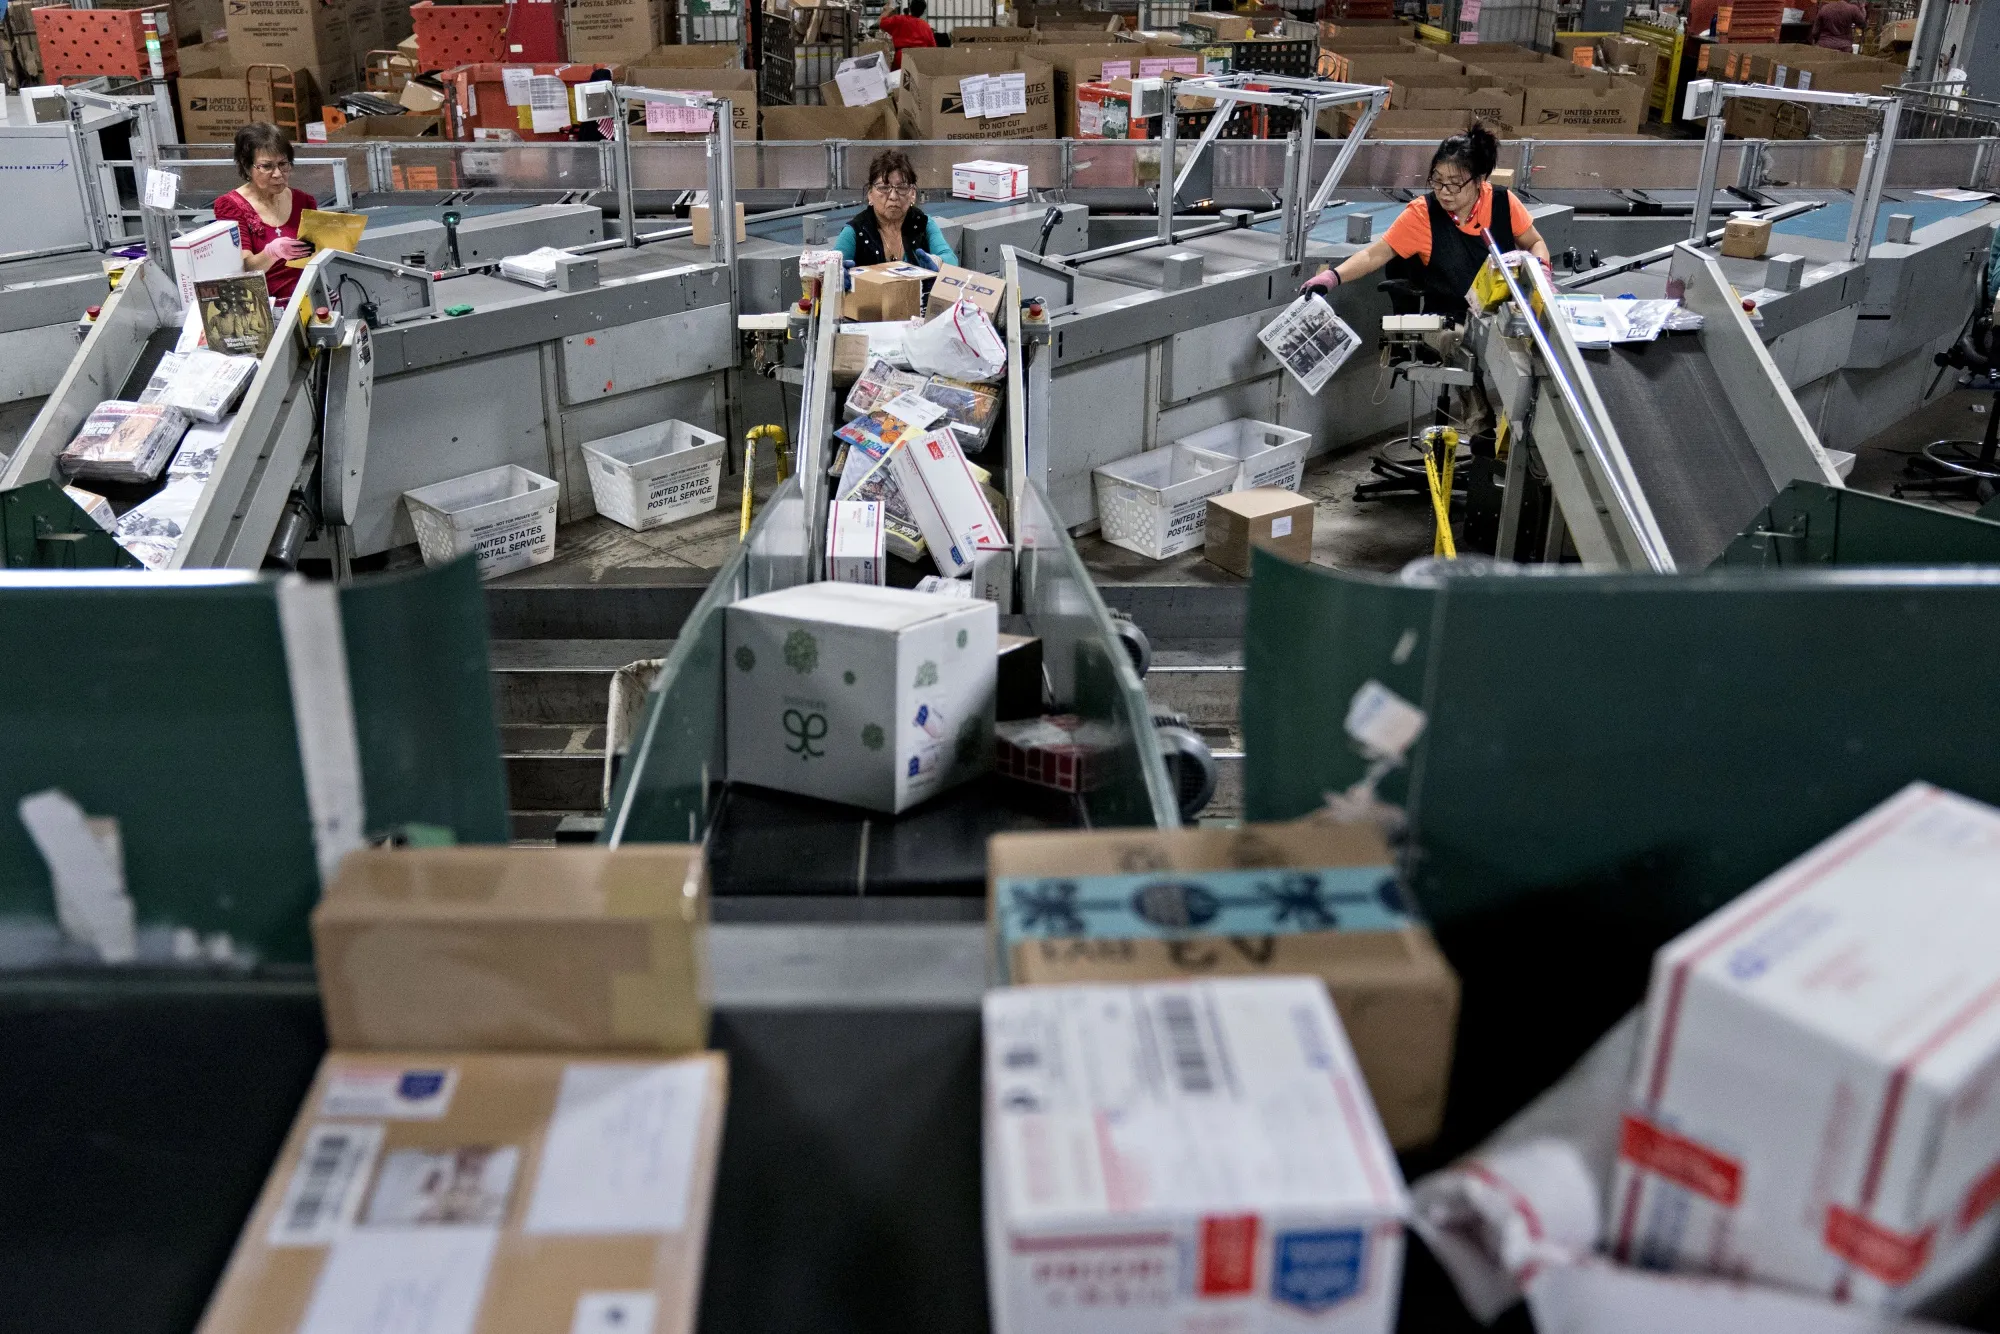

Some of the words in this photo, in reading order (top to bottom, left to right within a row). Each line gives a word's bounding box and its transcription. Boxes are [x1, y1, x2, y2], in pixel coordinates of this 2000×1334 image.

[1026, 82, 1046, 93] ATES
[1026, 95, 1048, 106] RVICE
[948, 132, 986, 140] DESIGNED
[1003, 127, 1034, 136] MULTIPLE
[194, 243, 214, 255] PRIORITY
[200, 252, 211, 260] MAIL
[181, 273, 190, 304] PRIORITY
[1264, 321, 1284, 342] Catholic
[1274, 474, 1294, 486] STATES
[650, 486, 679, 500] UNITED
[680, 476, 710, 491] STATES
[648, 496, 678, 510] POSTAL
[680, 485, 713, 501] SERVICE
[474, 524, 494, 532] WARNING
[515, 513, 530, 522] PRIVATE
[1171, 512, 1196, 527] UNITED
[474, 536, 507, 551] UNITED
[508, 526, 542, 542] STATES
[1167, 524, 1194, 538] POSTAL
[477, 546, 506, 560] OSTAL
[508, 534, 546, 552] SERVICE
